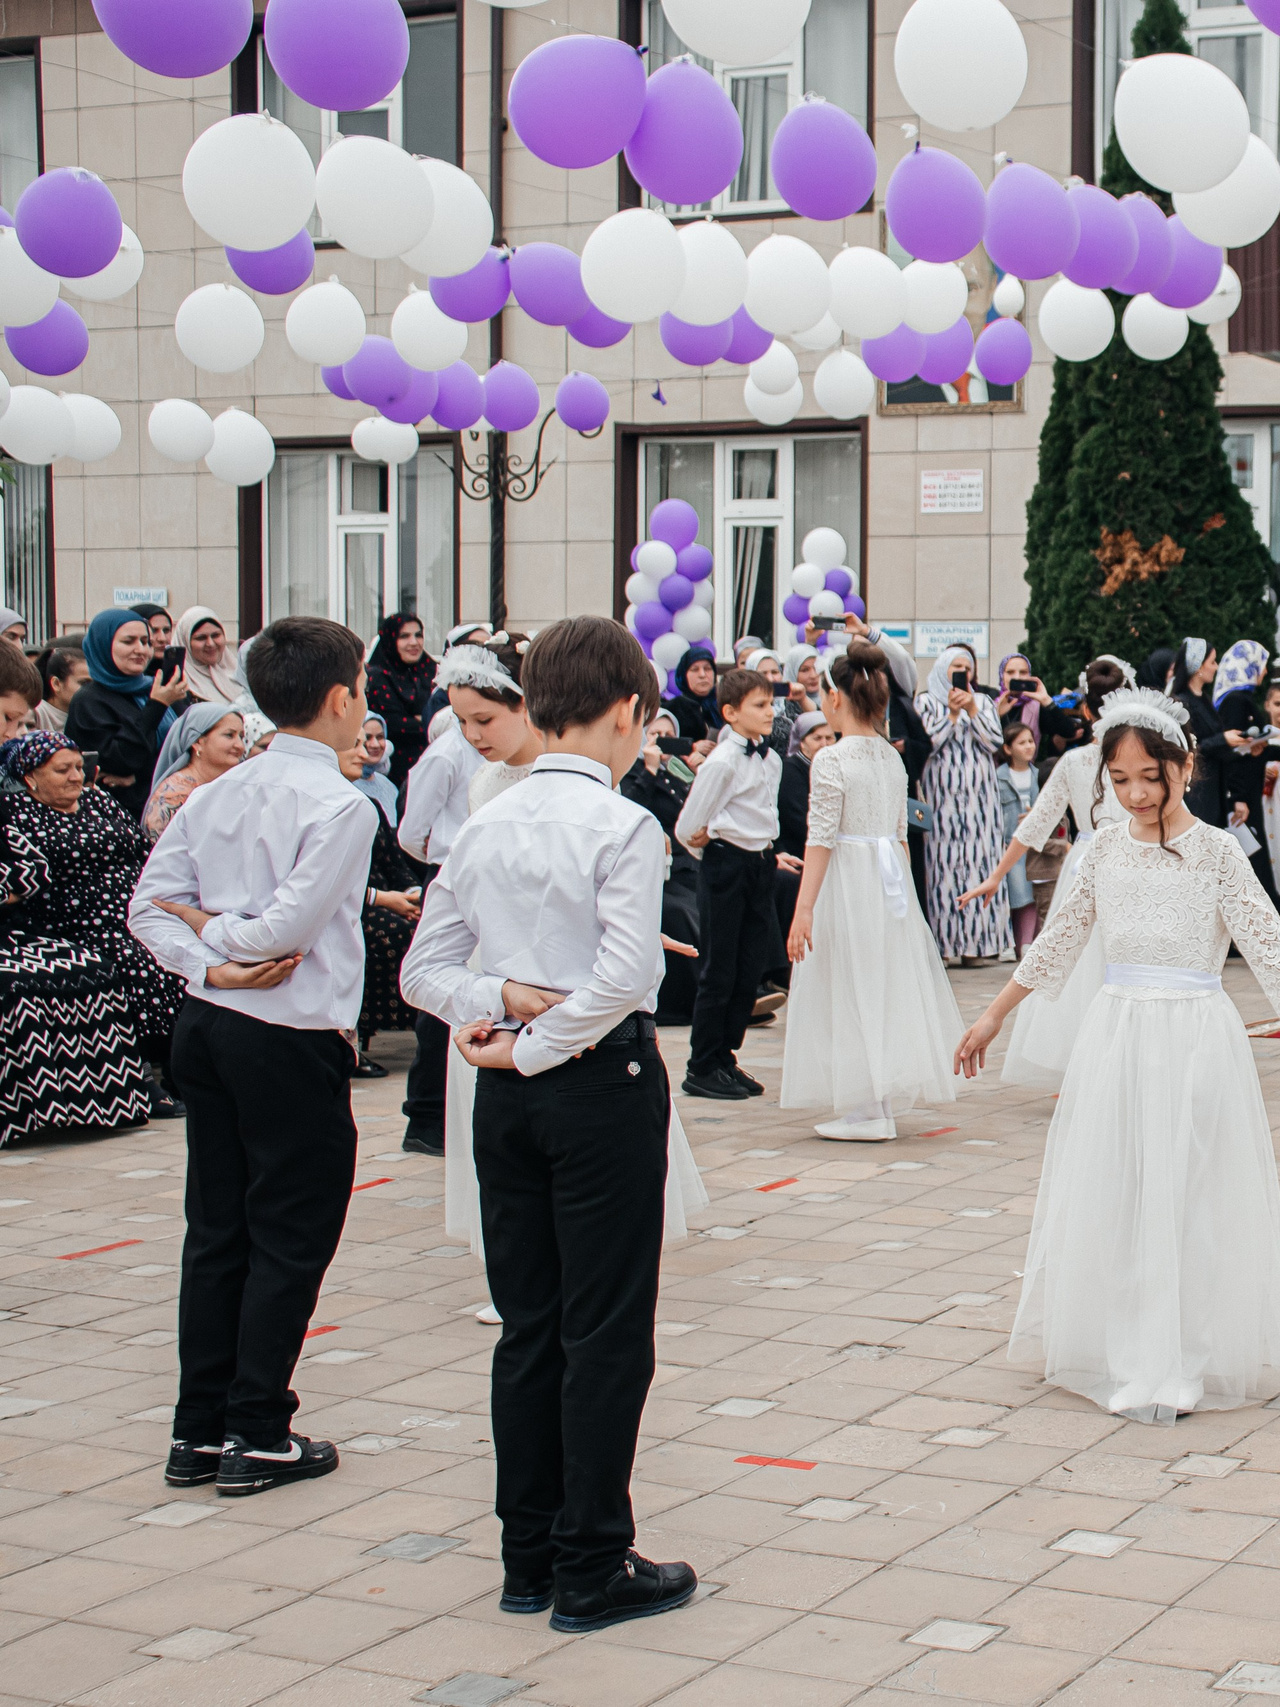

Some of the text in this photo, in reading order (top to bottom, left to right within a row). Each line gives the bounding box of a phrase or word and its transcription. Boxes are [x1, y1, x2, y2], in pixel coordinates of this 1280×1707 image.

[115, 589, 164, 602] ПОЖАРНЫЙ ЩИТ
[921, 625, 982, 634] ПОЖАРНЫЙ
